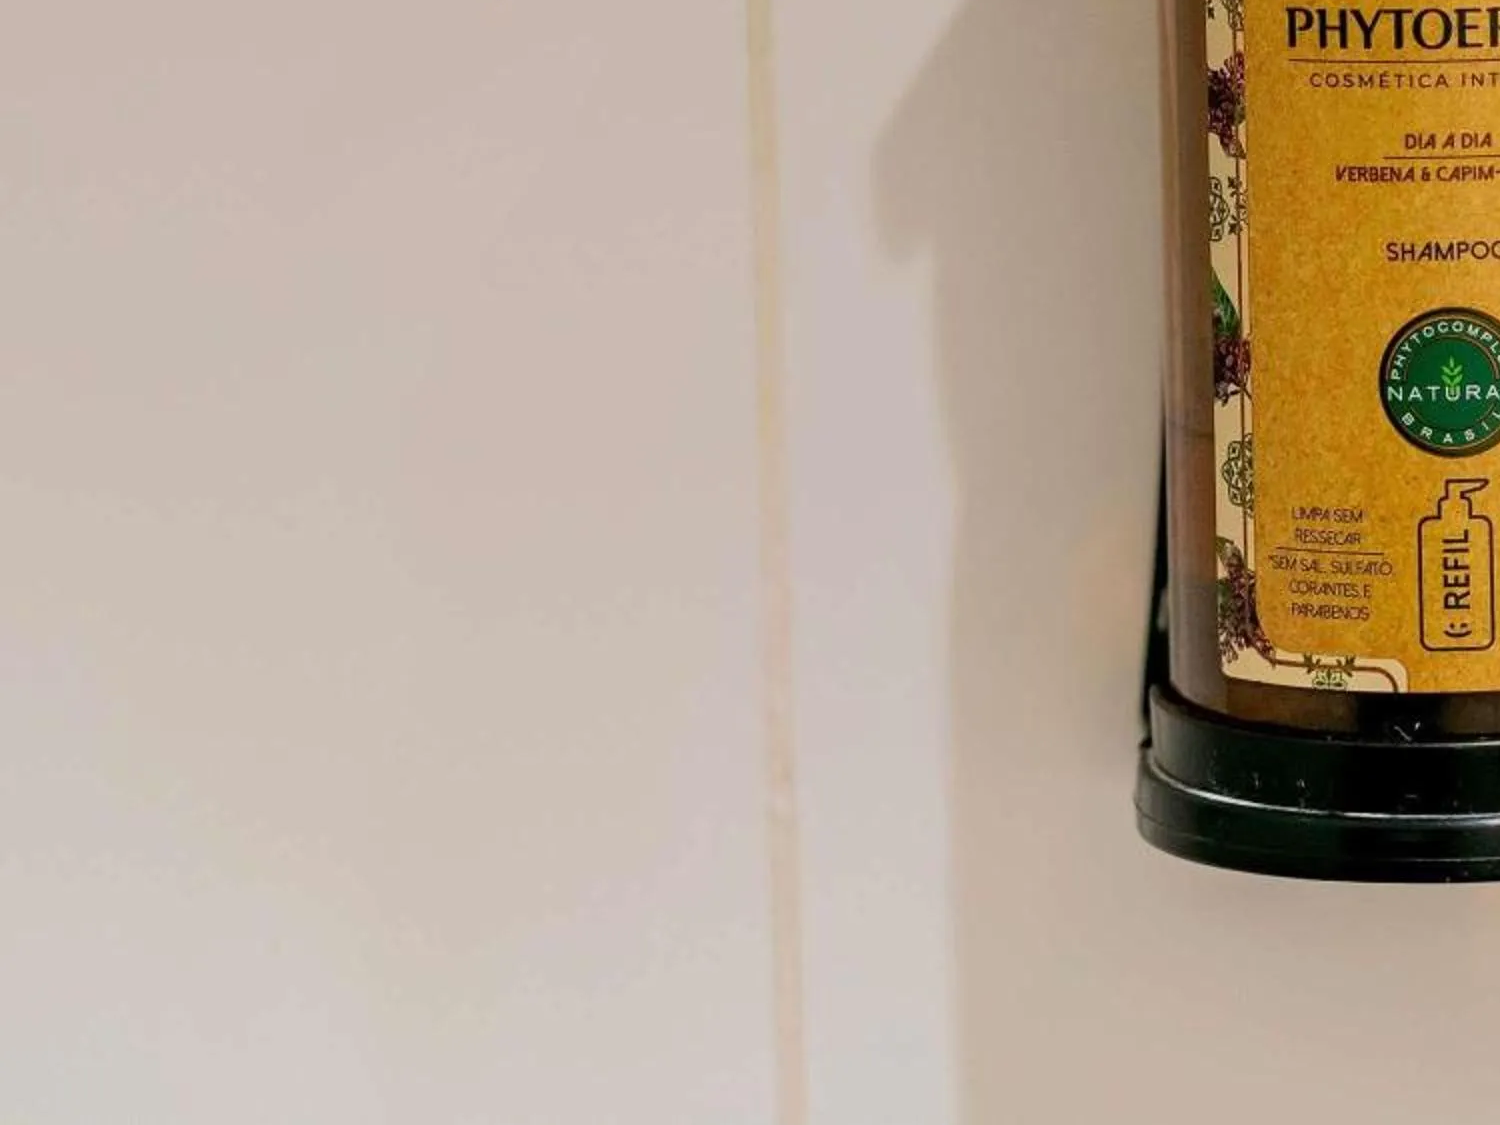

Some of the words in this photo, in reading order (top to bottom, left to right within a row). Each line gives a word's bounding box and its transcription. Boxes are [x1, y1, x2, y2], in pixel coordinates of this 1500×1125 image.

[1309, 71, 1449, 89] COSMÉTICA
[1404, 133, 1436, 150] DIA
[1442, 133, 1455, 148] A
[1461, 132, 1493, 149] DIA
[1335, 165, 1415, 183] VERBENA
[1421, 166, 1431, 182] &
[1334, 508, 1363, 523] SEM
[1295, 528, 1361, 545] RESSECAR
[1442, 529, 1470, 609] REFIL
